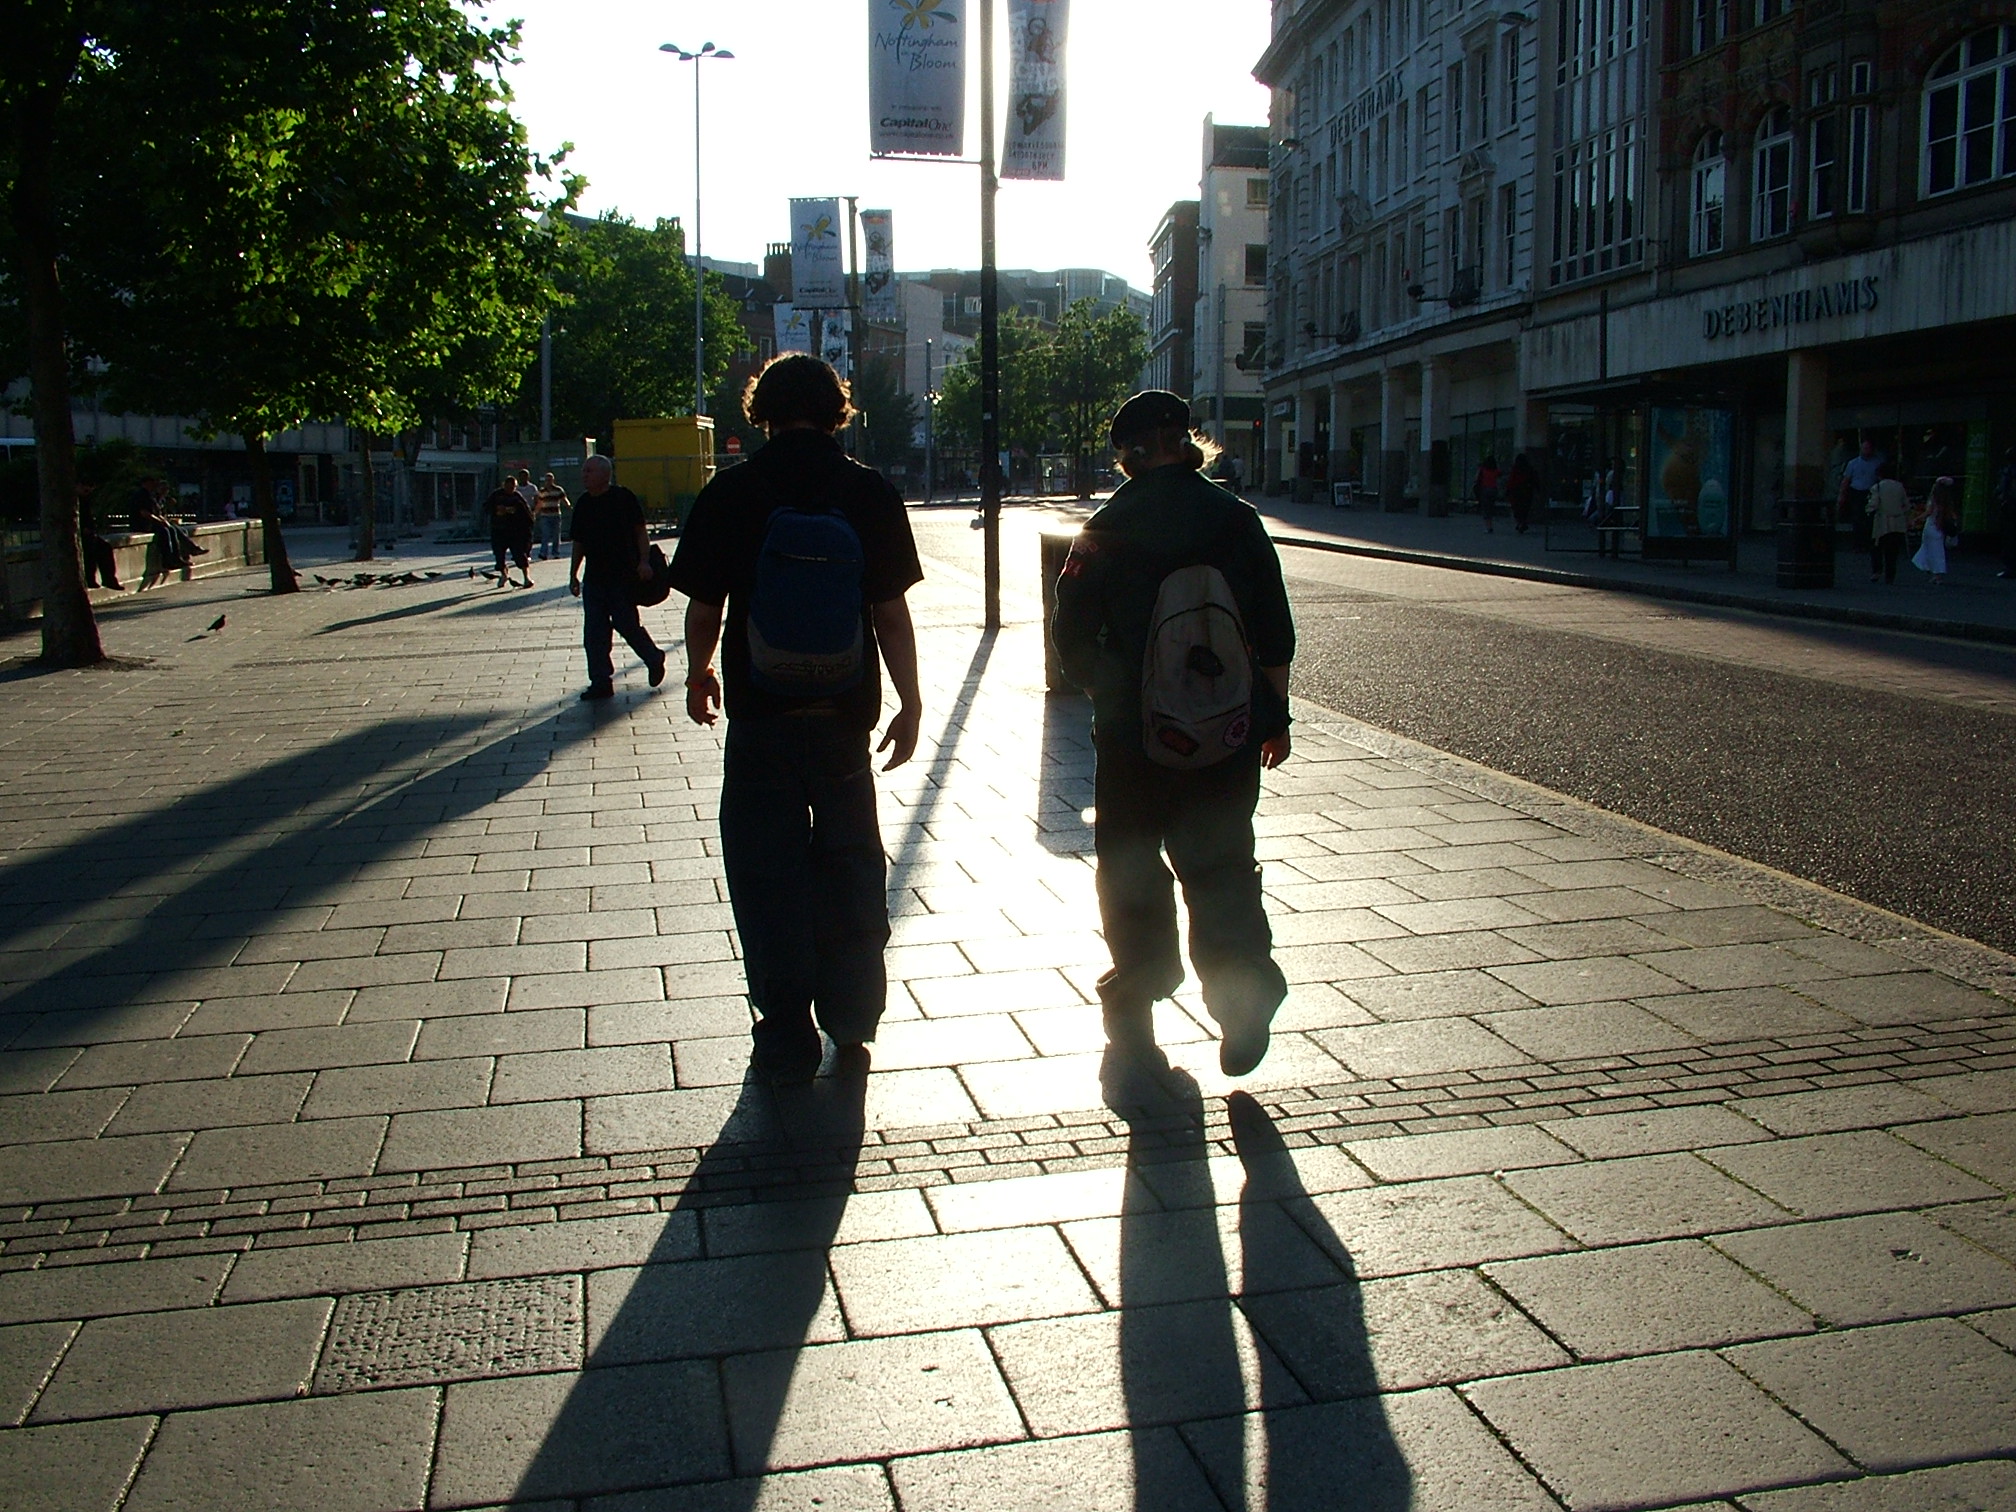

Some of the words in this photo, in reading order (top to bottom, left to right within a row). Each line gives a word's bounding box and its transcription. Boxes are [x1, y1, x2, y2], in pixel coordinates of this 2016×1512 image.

[874, 32, 958, 60] Nottingham
[909, 52, 956, 71] Bloom
[1330, 70, 1404, 148] DEBENHAMS
[1703, 275, 1879, 340] DEBENHAMS
